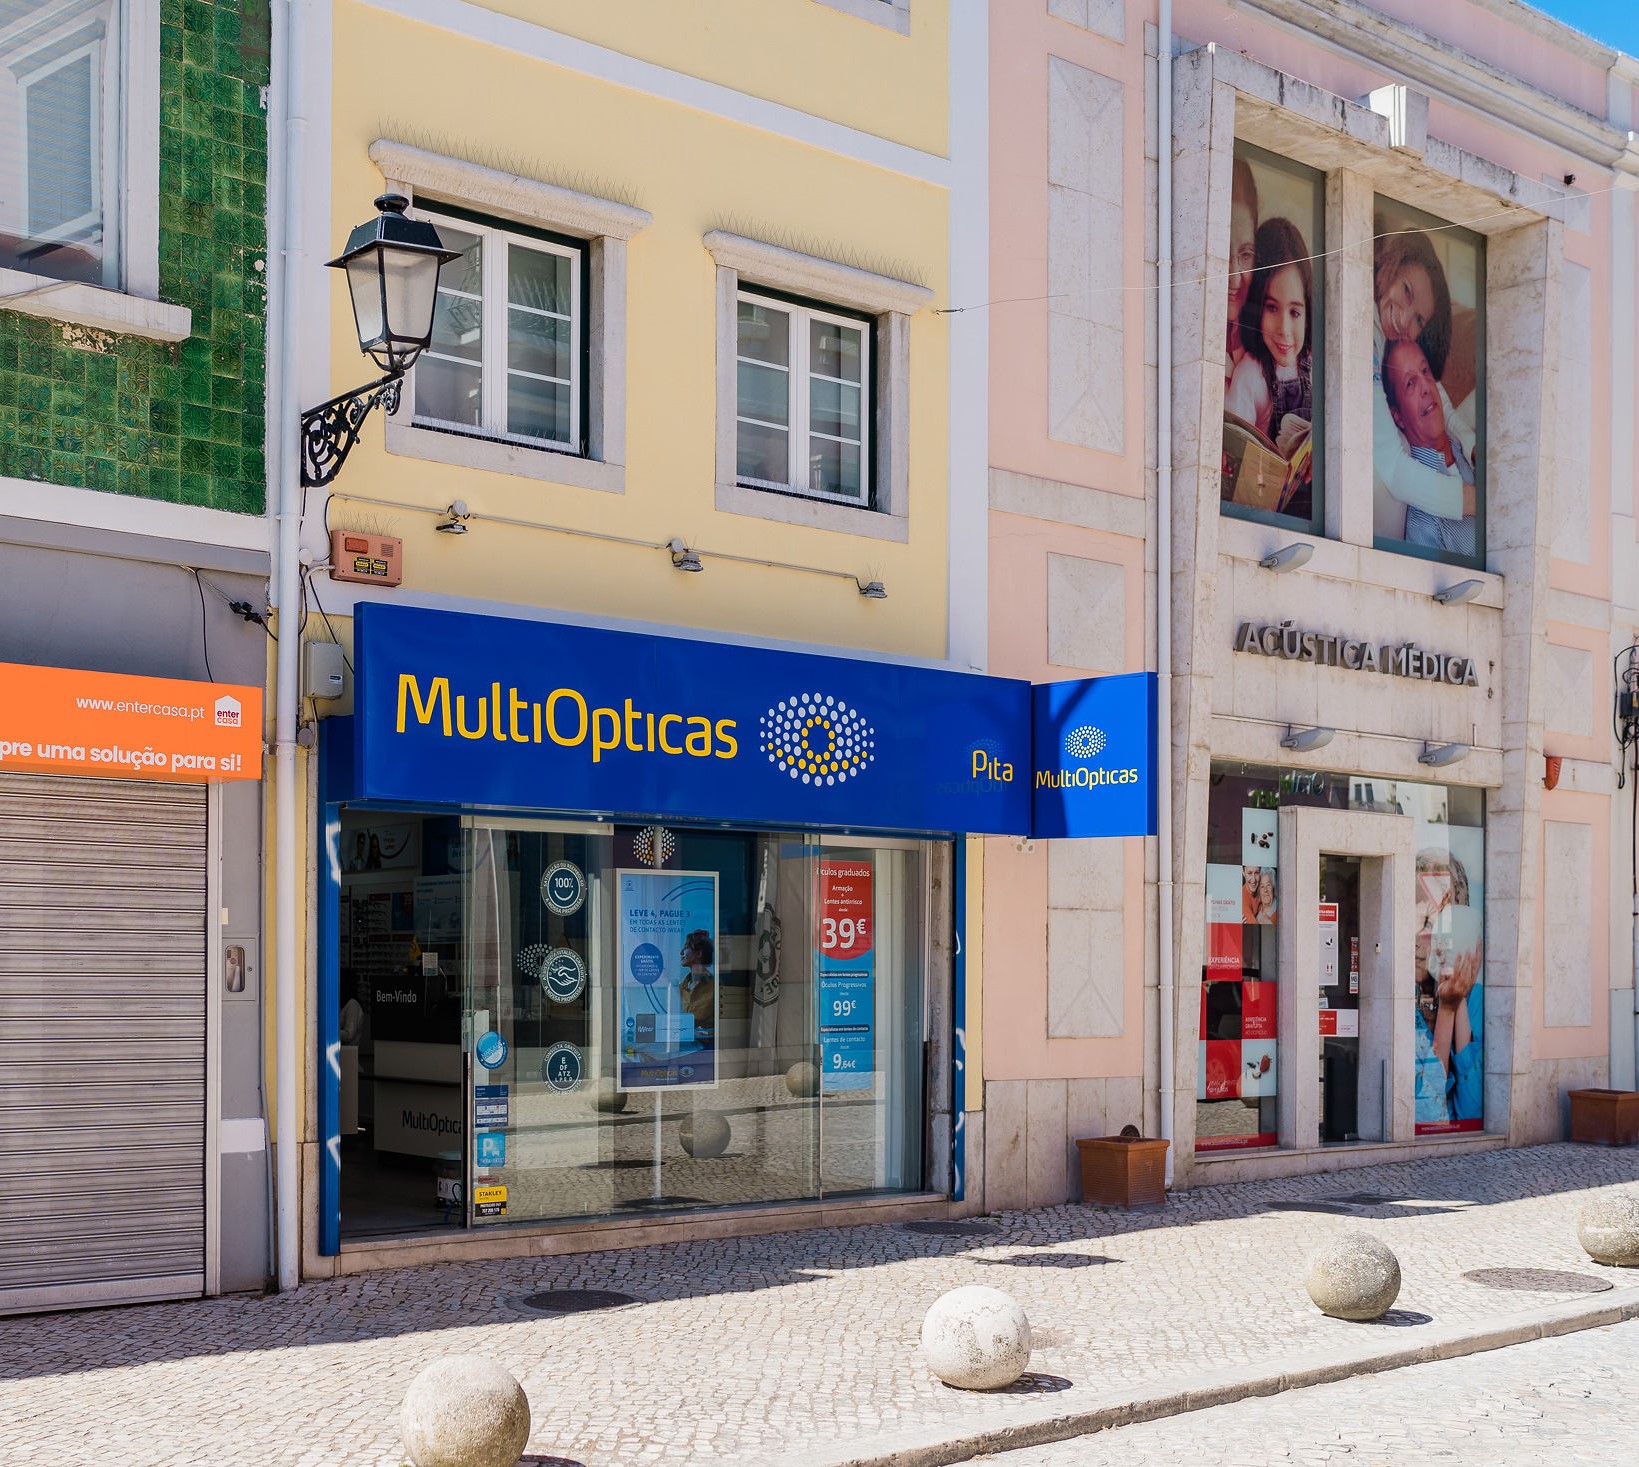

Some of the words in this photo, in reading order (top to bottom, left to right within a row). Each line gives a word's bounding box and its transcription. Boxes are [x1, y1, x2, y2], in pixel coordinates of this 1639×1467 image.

[1238, 619, 1380, 671] ACÚSTICA
[1384, 642, 1479, 687] MÉDICA
[76, 697, 205, 722] www.entercasa.pt
[216, 709, 239, 719] enter
[217, 717, 239, 725] casa
[396, 673, 738, 763] MultiOpticas
[37, 743, 85, 761] uma
[90, 745, 167, 770] solução
[171, 752, 216, 772] para
[220, 753, 242, 772] si!
[972, 749, 1014, 782] Pita
[1035, 767, 1139, 791] MultiOpticas
[838, 868, 870, 878] graduados
[554, 877, 574, 888] 100%
[832, 885, 853, 893] Armação
[629, 909, 648, 917] LEVE
[659, 910, 684, 918] PAGUE
[686, 910, 691, 918] 3
[822, 917, 867, 949] 39€
[376, 990, 417, 1003] Bem-Vindo
[833, 1000, 856, 1017] 99€
[561, 1056, 566, 1065] E
